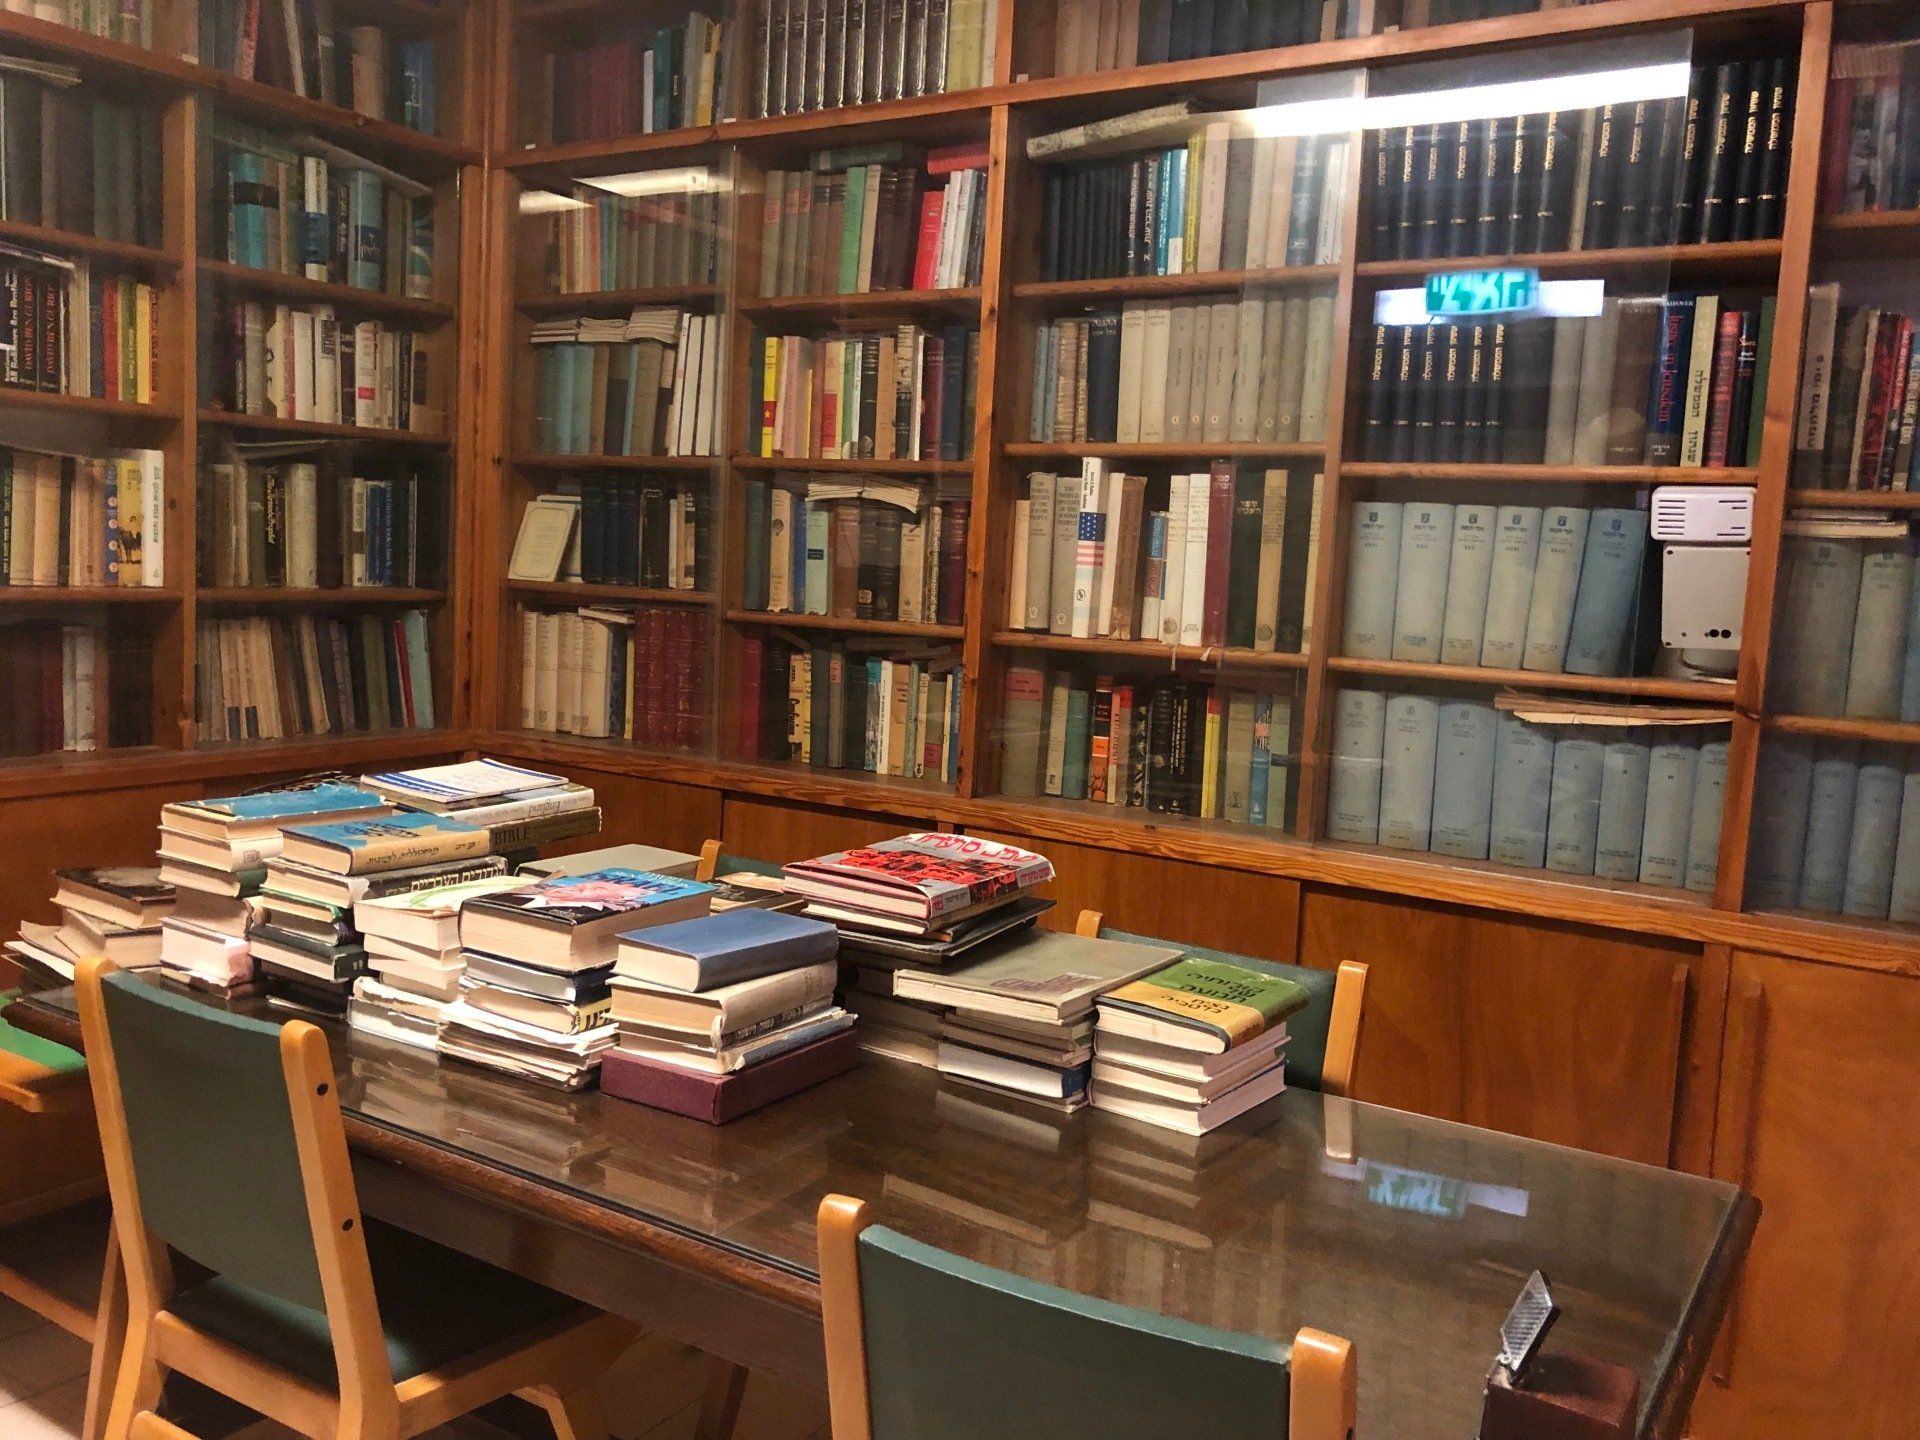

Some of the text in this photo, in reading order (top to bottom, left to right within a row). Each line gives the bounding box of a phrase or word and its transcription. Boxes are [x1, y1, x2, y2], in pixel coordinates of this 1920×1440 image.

[1716, 118, 1728, 155] הממשלה
[1744, 91, 1759, 154] שנתון הממשלה
[1768, 86, 1783, 150] שנתון הממשלה
[24, 340, 33, 370] DAVID
[46, 345, 55, 374] DAVID
[1371, 326, 1385, 381] שנתון הממשלה
[1400, 326, 1412, 381] שנתון הממשלה
[1422, 326, 1435, 381] שנתון הממשלה
[1446, 325, 1458, 381] שנתון הממשלה
[1470, 326, 1482, 382] שנתון הממשלה
[1492, 324, 1504, 381] שנתון הממשלה
[1658, 314, 1684, 422] Justice in Jerusalem
[1687, 369, 1708, 463] שנתון הממשלה
[494, 826, 532, 846] BIBLE
[410, 873, 460, 893] העבריים
